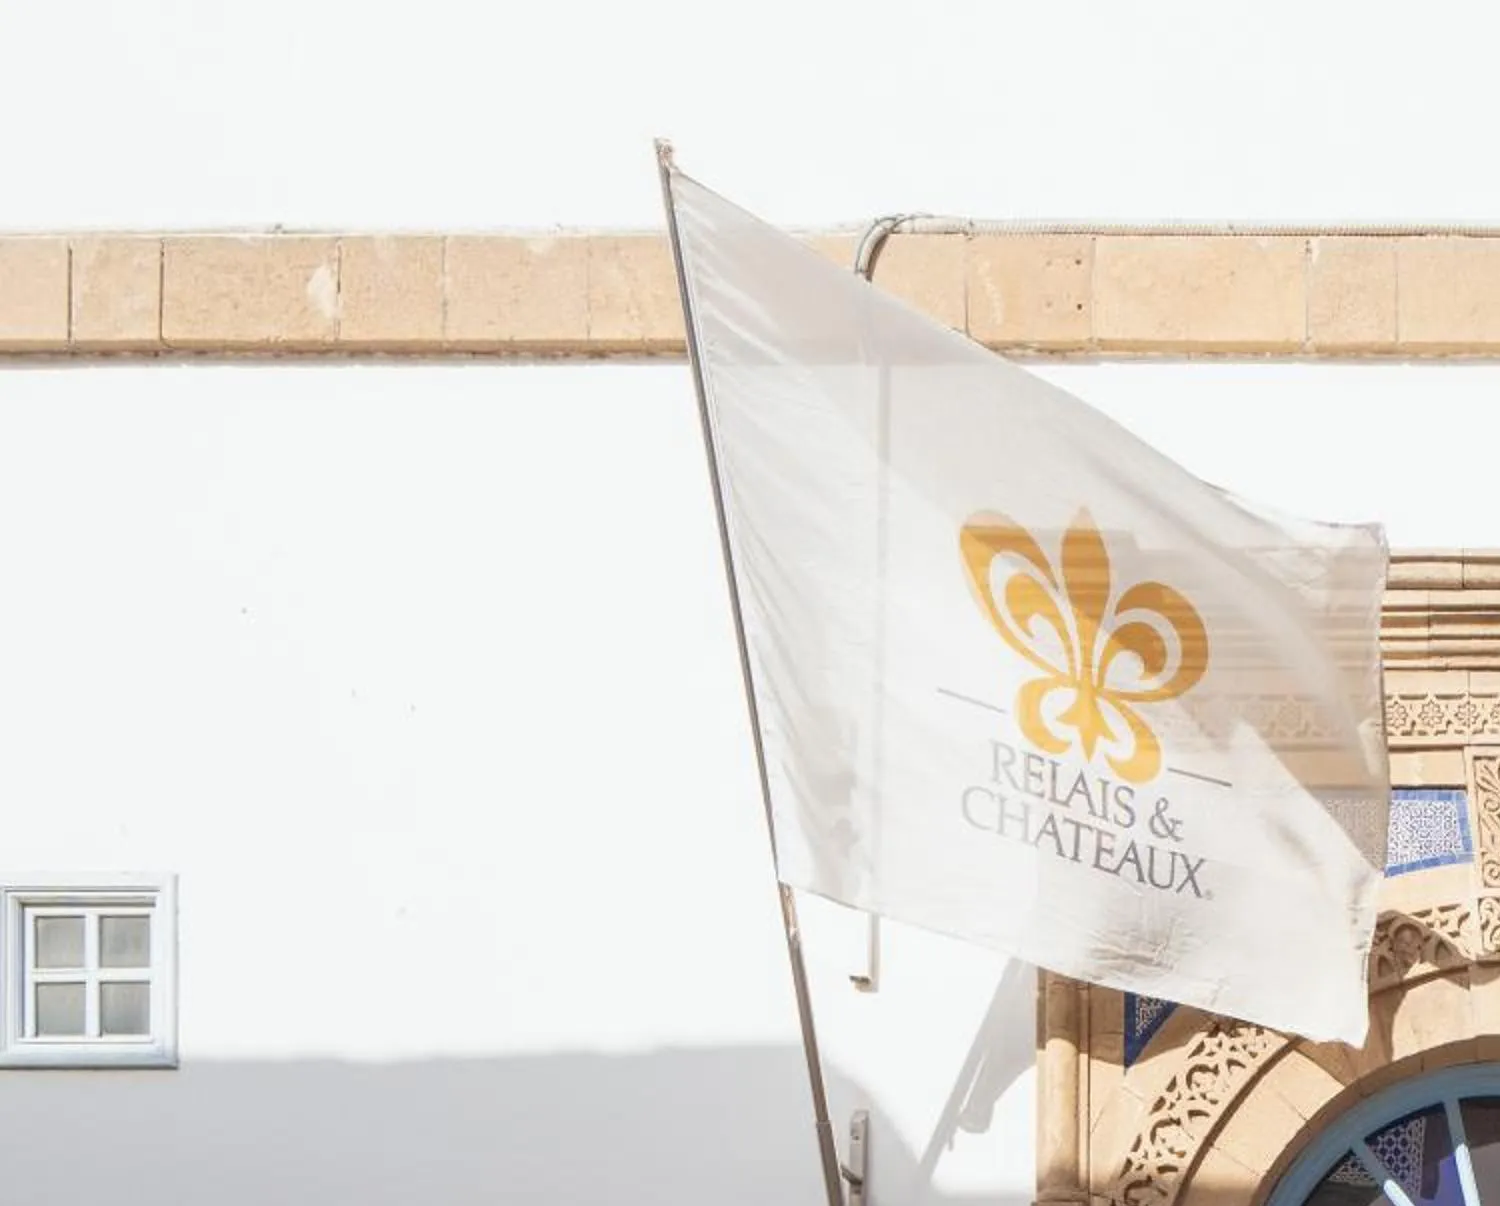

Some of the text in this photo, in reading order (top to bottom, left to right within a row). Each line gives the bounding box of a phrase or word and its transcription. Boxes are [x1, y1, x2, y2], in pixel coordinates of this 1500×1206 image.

[961, 785, 1207, 899] CHATEAUX
[989, 738, 1184, 842] RELAIS &
